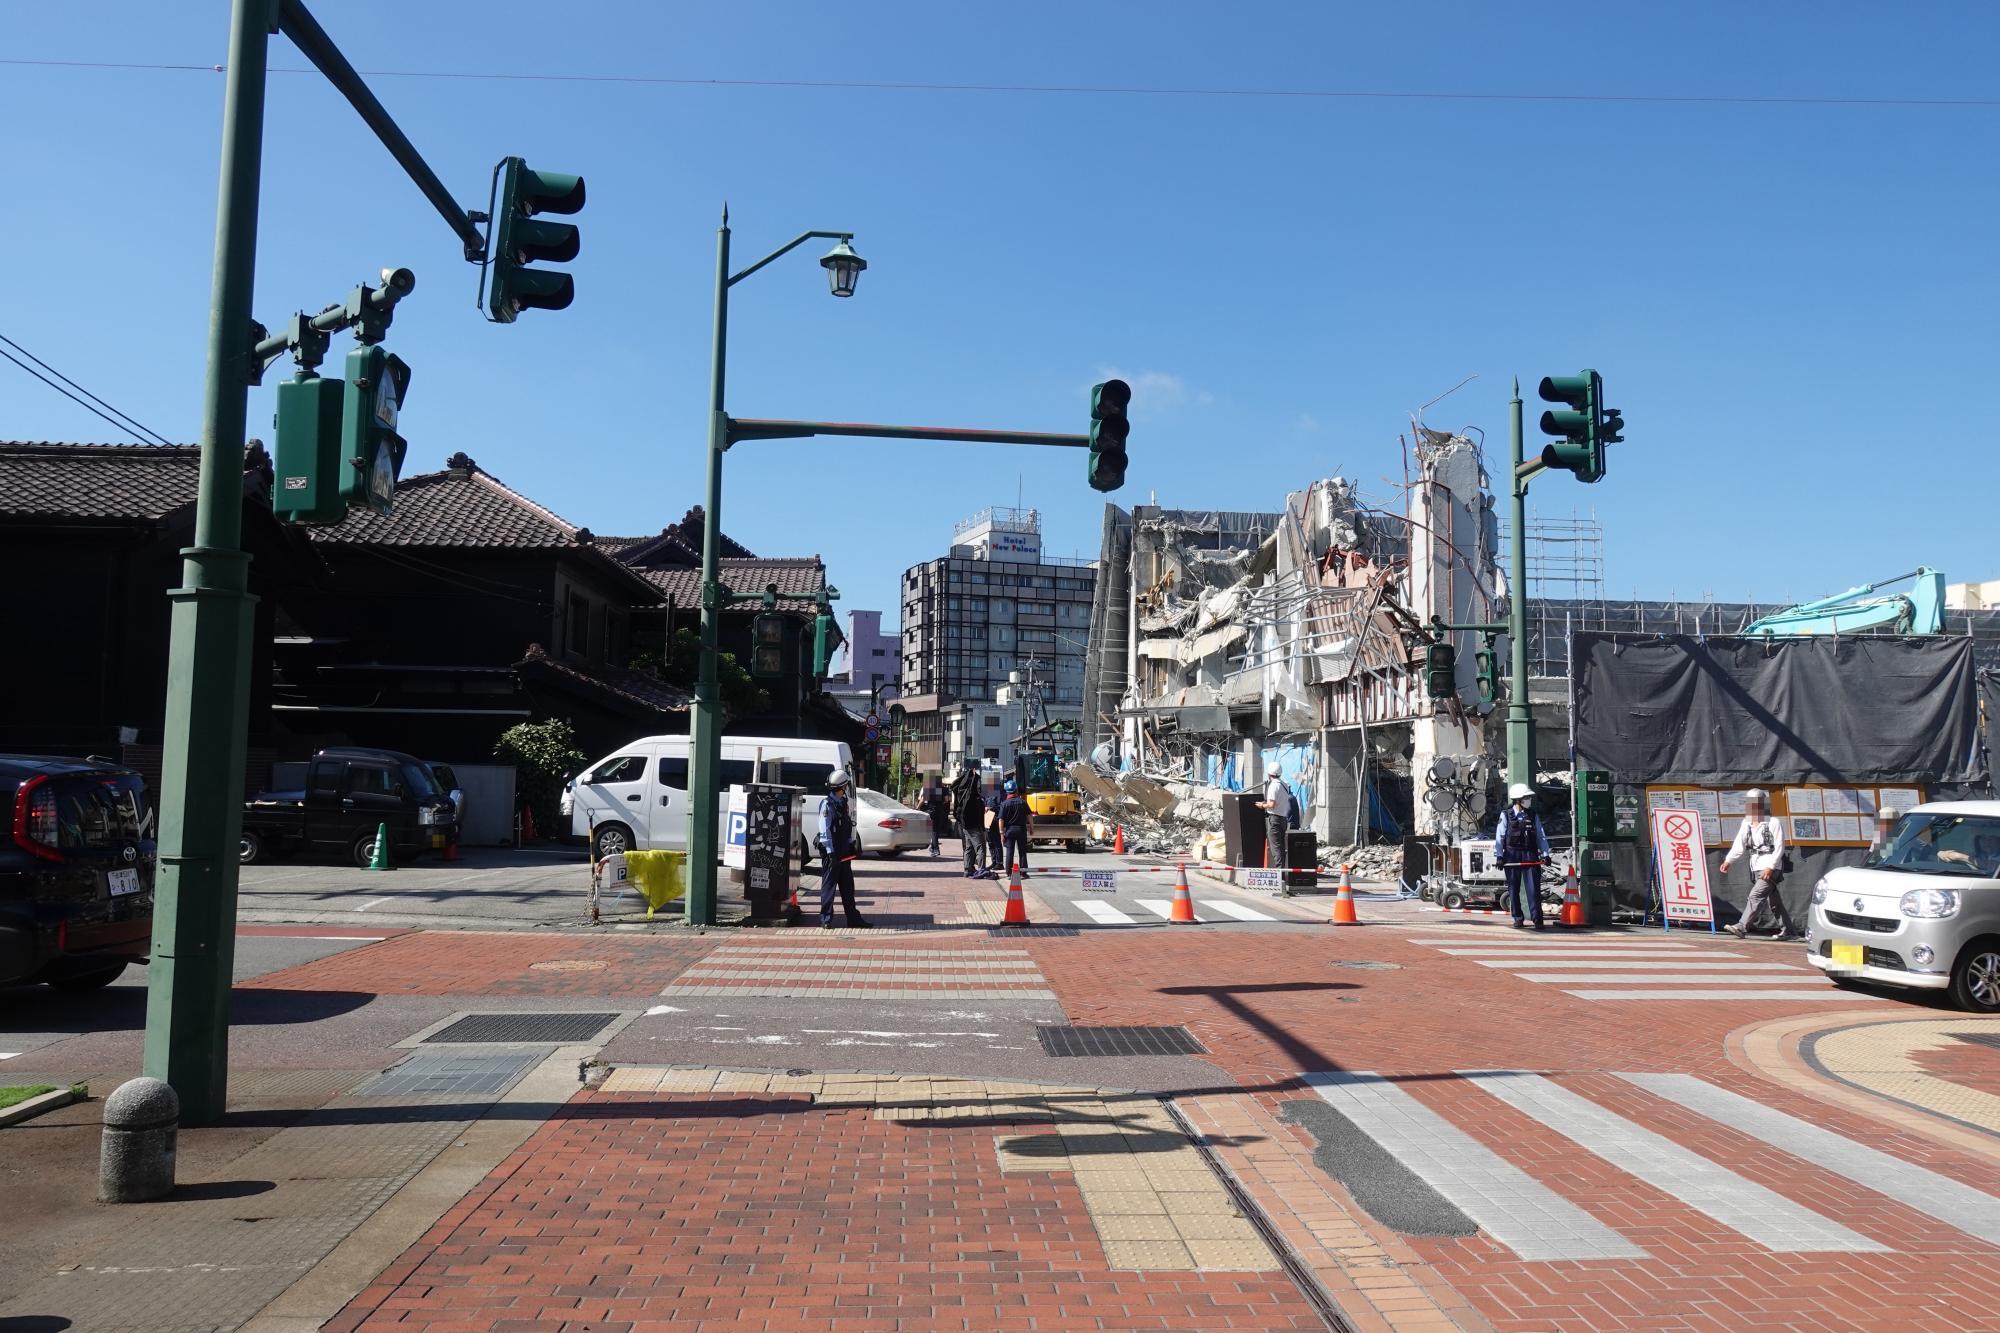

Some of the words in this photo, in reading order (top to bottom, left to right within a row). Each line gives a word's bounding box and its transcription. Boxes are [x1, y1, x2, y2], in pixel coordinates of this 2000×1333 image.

[1003, 536, 1026, 545] Hotel
[992, 543, 1009, 551] New
[1011, 544, 1037, 553] Palace
[730, 814, 747, 843] P
[618, 869, 626, 880] P
[1671, 842, 1698, 901] 通行止
[1092, 880, 1115, 888] 立入禁止
[1256, 879, 1279, 887] 立入禁止
[1671, 906, 1706, 916] 会津若松市
